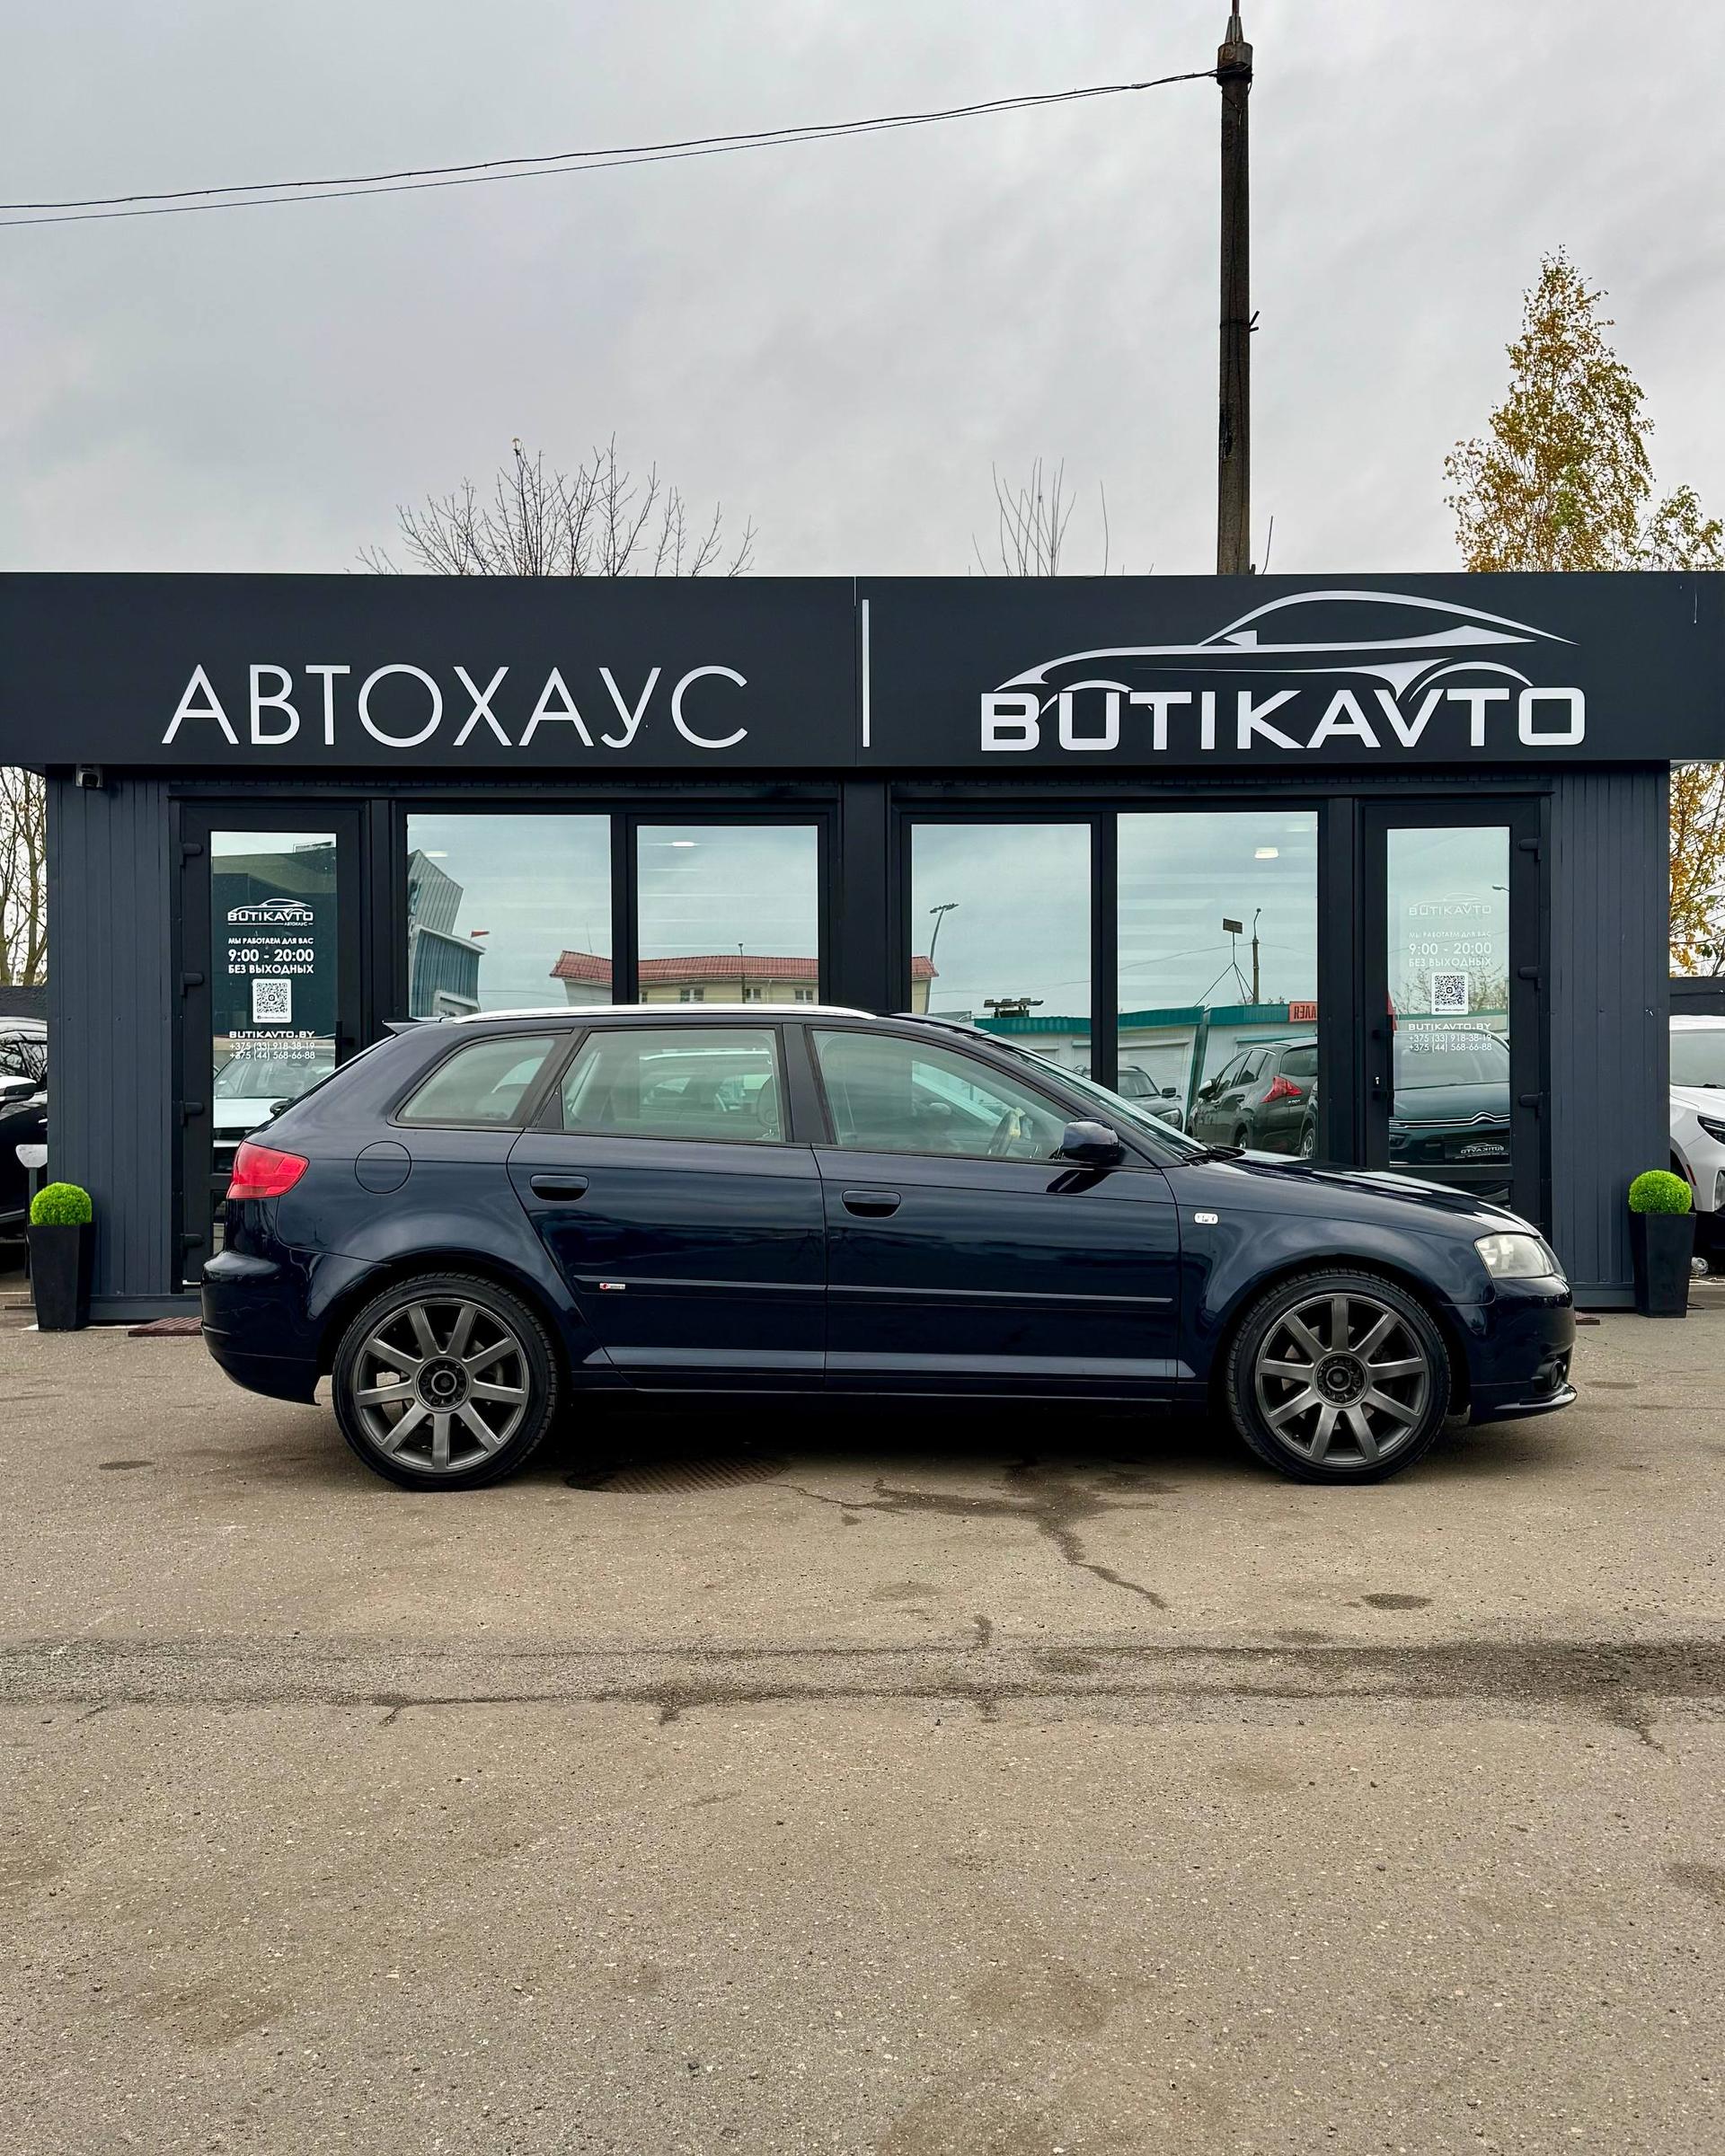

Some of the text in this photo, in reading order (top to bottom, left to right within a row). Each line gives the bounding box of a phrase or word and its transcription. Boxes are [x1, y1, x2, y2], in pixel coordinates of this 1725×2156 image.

[162, 663, 748, 749] АВТОХАУС
[980, 687, 1587, 752] BUTIKAVTO
[1408, 905, 1492, 916] BUTIKAVTO
[227, 911, 314, 922] BUTIKAVTO
[228, 937, 314, 946] МЫ РАБОТАЕМ ДЛЯ ВАС
[1409, 942, 1438, 955] 9:00
[1453, 941, 1492, 954] 20:00
[228, 948, 260, 962] 9:00
[273, 948, 314, 962] 20:00
[1409, 957, 1492, 968] БЕЗ ВЫХОДНЫХ
[228, 964, 314, 975] БЕЗ ВЫХОДНЫХ
[229, 1030, 315, 1038] BUTIKAVTO.BY
[1409, 1034, 1429, 1042] +375
[1450, 1034, 1492, 1042] 918-38-19
[253, 1042, 270, 1052] (33)
[272, 1042, 315, 1050] 918-38-19
[1409, 1043, 1492, 1053] +375 (44) 568-66-88
[253, 1051, 270, 1061] (44)
[272, 1051, 316, 1060] 568-66-88
